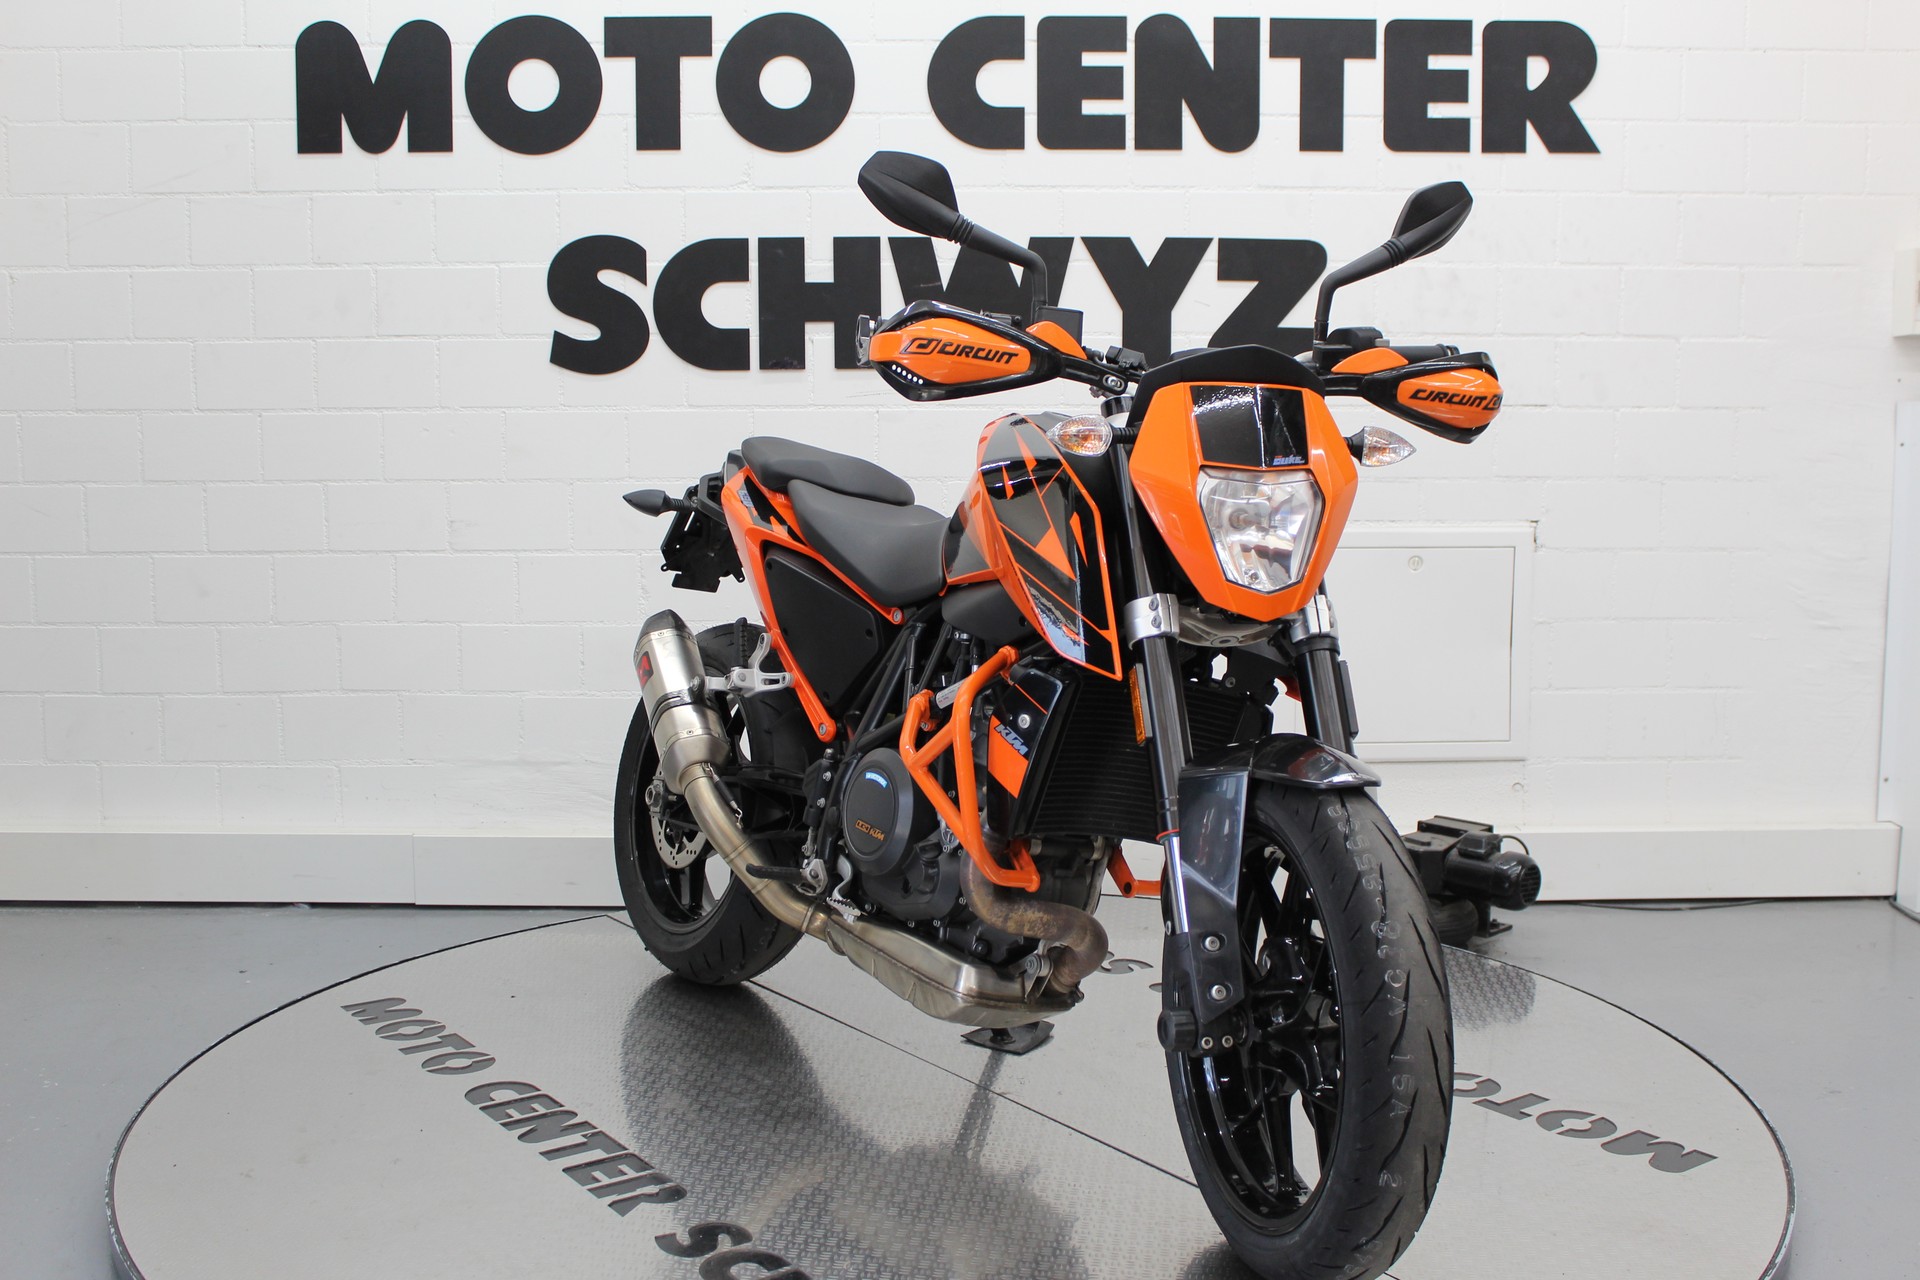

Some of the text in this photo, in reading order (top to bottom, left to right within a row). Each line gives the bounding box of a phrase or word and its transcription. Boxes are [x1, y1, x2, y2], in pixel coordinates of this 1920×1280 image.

[295, 12, 1601, 155] MOTO CENTER
[547, 234, 1329, 375] SCHWYZ
[937, 341, 1019, 365] CIRCUIT
[1408, 388, 1487, 408] CIRCUIT
[994, 723, 1029, 756] KTM
[869, 828, 885, 841] KTM
[341, 997, 497, 1075] MOTO
[464, 1081, 688, 1217] CENTER
[1453, 1072, 1718, 1173] MOTO
